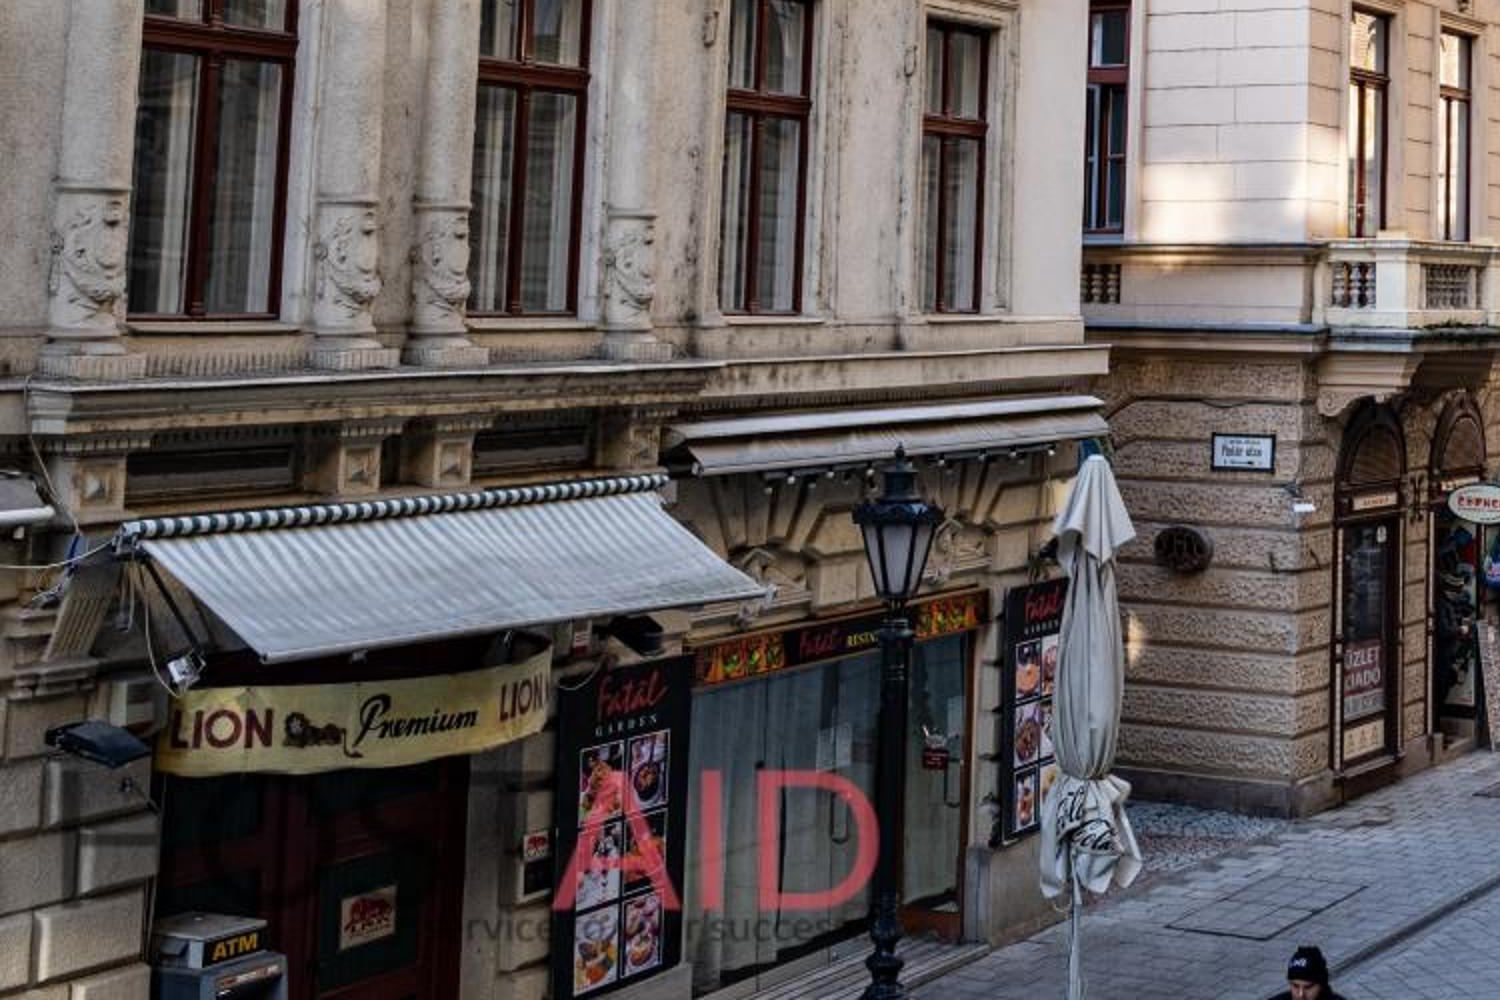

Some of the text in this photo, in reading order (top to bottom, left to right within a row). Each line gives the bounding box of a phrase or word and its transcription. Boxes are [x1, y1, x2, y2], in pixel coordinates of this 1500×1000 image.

[170, 672, 544, 750] LION Premium LION
[211, 932, 258, 961] ATM
